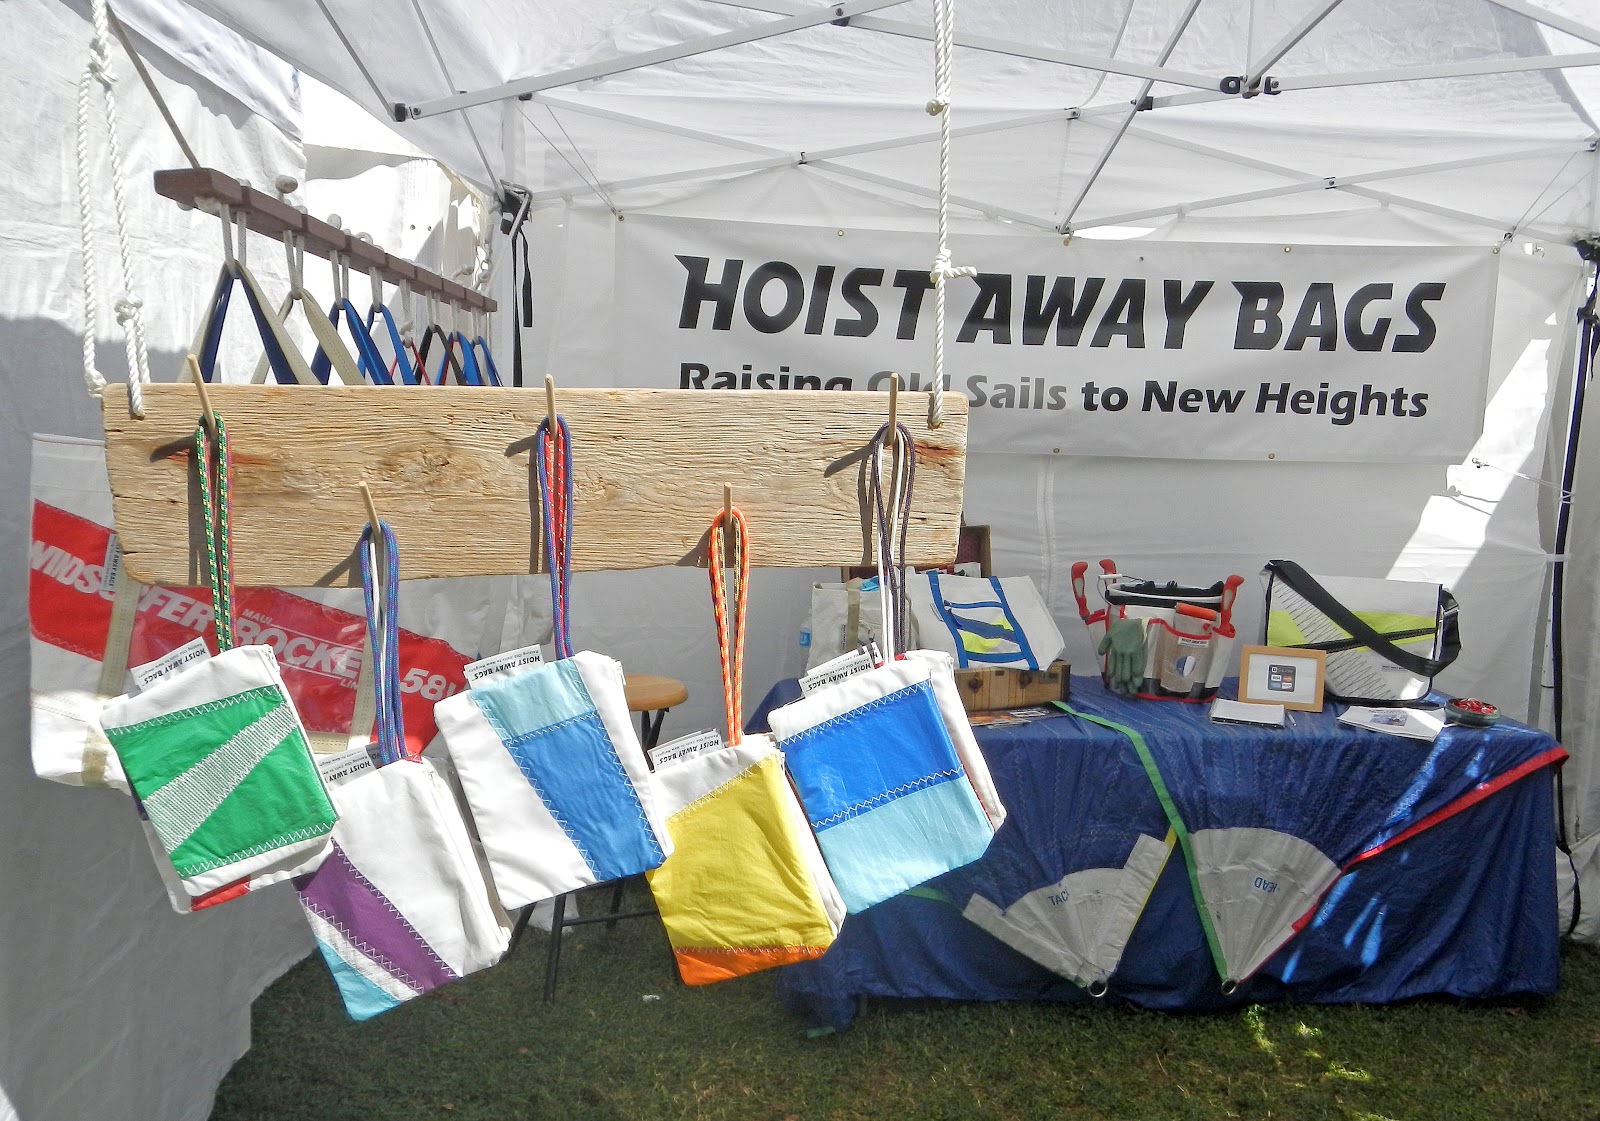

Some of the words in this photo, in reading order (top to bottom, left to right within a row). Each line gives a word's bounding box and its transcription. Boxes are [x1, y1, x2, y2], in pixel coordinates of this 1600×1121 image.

[673, 255, 935, 341] HOIST
[955, 272, 1215, 349] AWAY
[1231, 280, 1447, 354] BAGS
[867, 370, 952, 392] Ol
[968, 375, 1068, 411] Sails
[1081, 381, 1128, 412] to
[1141, 380, 1247, 414] New
[1255, 382, 1430, 426] Heights
[30, 540, 215, 632] WINDSFER
[242, 608, 273, 624] MAUI
[236, 617, 363, 679] ROCKE
[184, 648, 206, 662] HOIST
[518, 656, 541, 666] HOIST
[164, 659, 183, 673] AWAY
[495, 662, 516, 673] AWAY
[850, 662, 871, 675] HOIST
[144, 671, 164, 684] BAGS
[474, 668, 493, 680] BAGS
[829, 671, 848, 683] AWAY
[808, 679, 826, 691] BAGS
[678, 745, 698, 757] AWAY
[700, 739, 720, 750] HOIST
[659, 752, 677, 765] BAGS
[350, 761, 371, 773] HOIST
[329, 770, 348, 782] AWAY
[1254, 876, 1278, 894] HEAD
[1047, 885, 1070, 906] TAC
